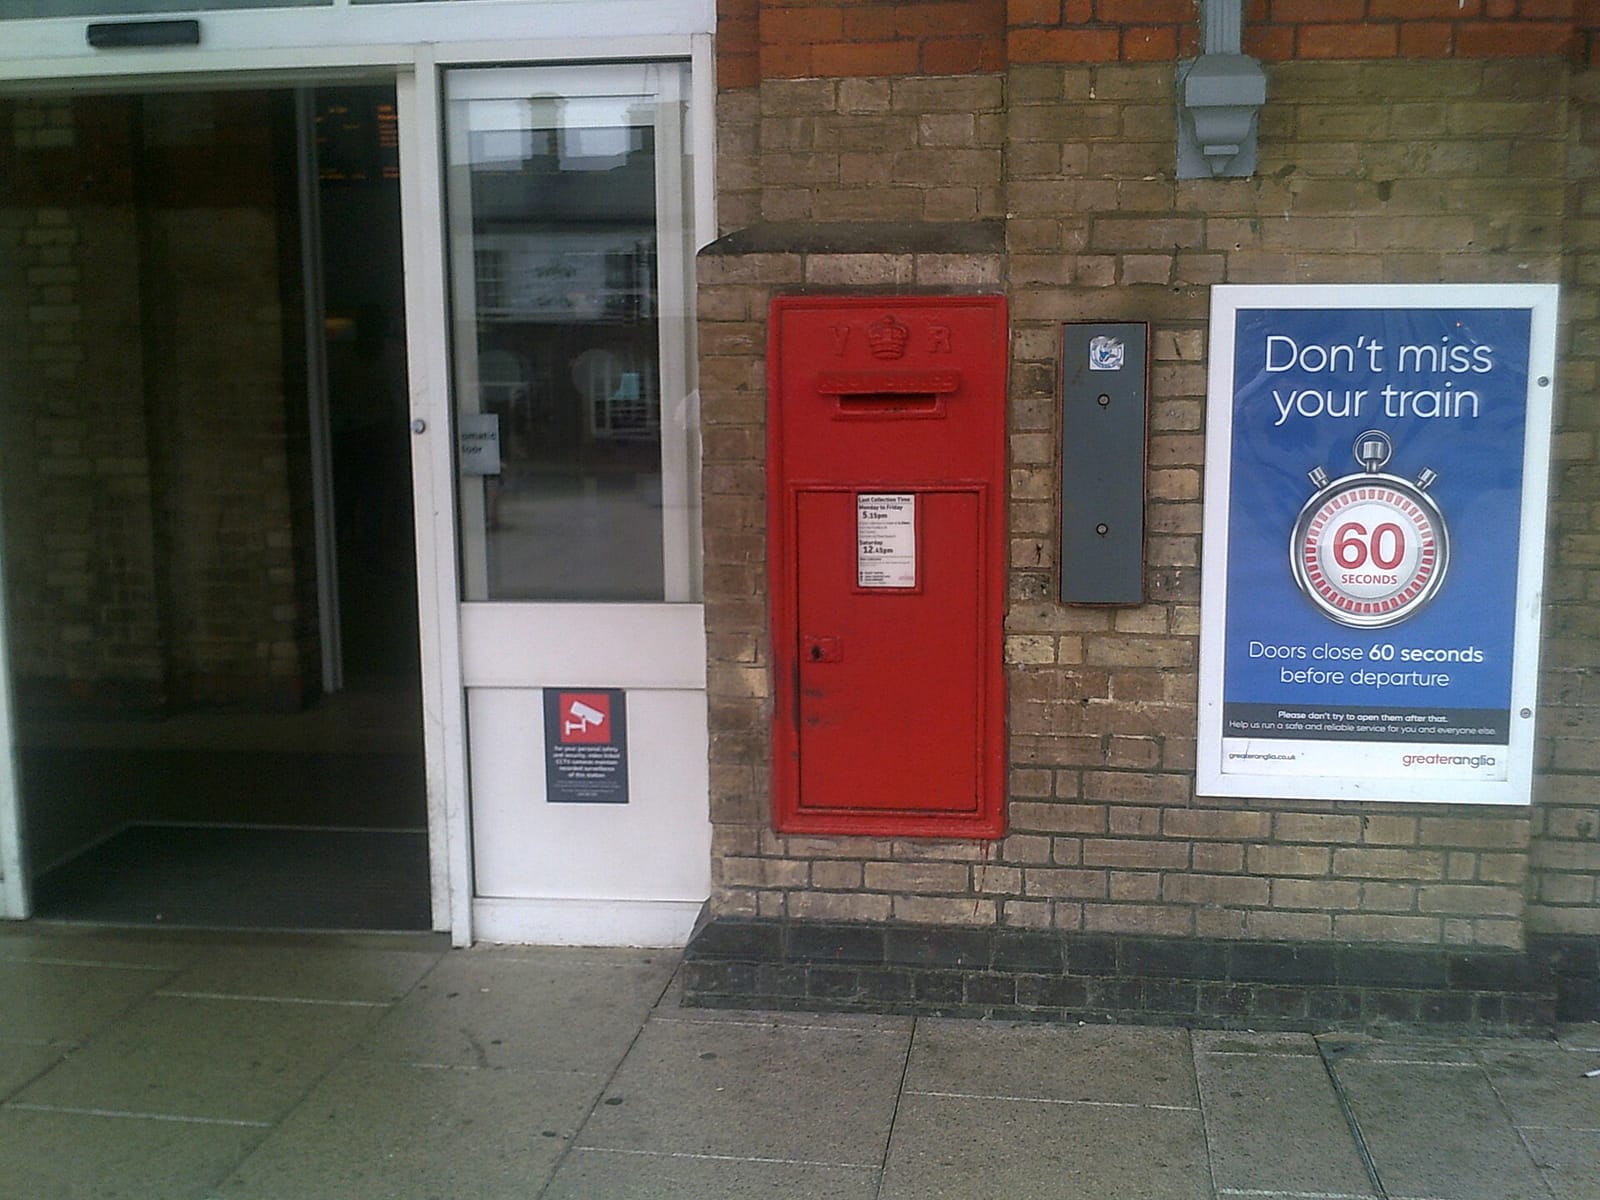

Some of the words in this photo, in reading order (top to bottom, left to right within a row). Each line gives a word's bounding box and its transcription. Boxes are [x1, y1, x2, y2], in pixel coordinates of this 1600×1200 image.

[1265, 335, 1383, 373] Don't
[1398, 336, 1493, 373] miss
[1273, 388, 1368, 426] your
[1381, 381, 1480, 418] train
[1333, 522, 1405, 570] 60
[1341, 574, 1398, 585] SECONDS
[1249, 641, 1306, 659] Doors
[1312, 643, 1363, 660] close
[1369, 644, 1395, 660] 60
[1401, 646, 1484, 662] seconds
[1281, 666, 1344, 684] before
[1350, 668, 1450, 689] departure
[1278, 710, 1306, 719] Please
[1308, 712, 1330, 720] don't
[1332, 713, 1344, 721] try
[1357, 715, 1379, 723] open
[1229, 720, 1249, 729] Help
[1285, 722, 1303, 730] safe
[1305, 722, 1322, 730] and
[1324, 723, 1355, 731] reliable
[1356, 724, 1386, 732] service
[1387, 724, 1399, 732] for
[1400, 725, 1416, 734] you
[1418, 725, 1435, 733] and
[1437, 727, 1476, 736] everyone
[1229, 753, 1296, 761] greateranglia.co.uk
[1402, 753, 1496, 769] greateranglia
